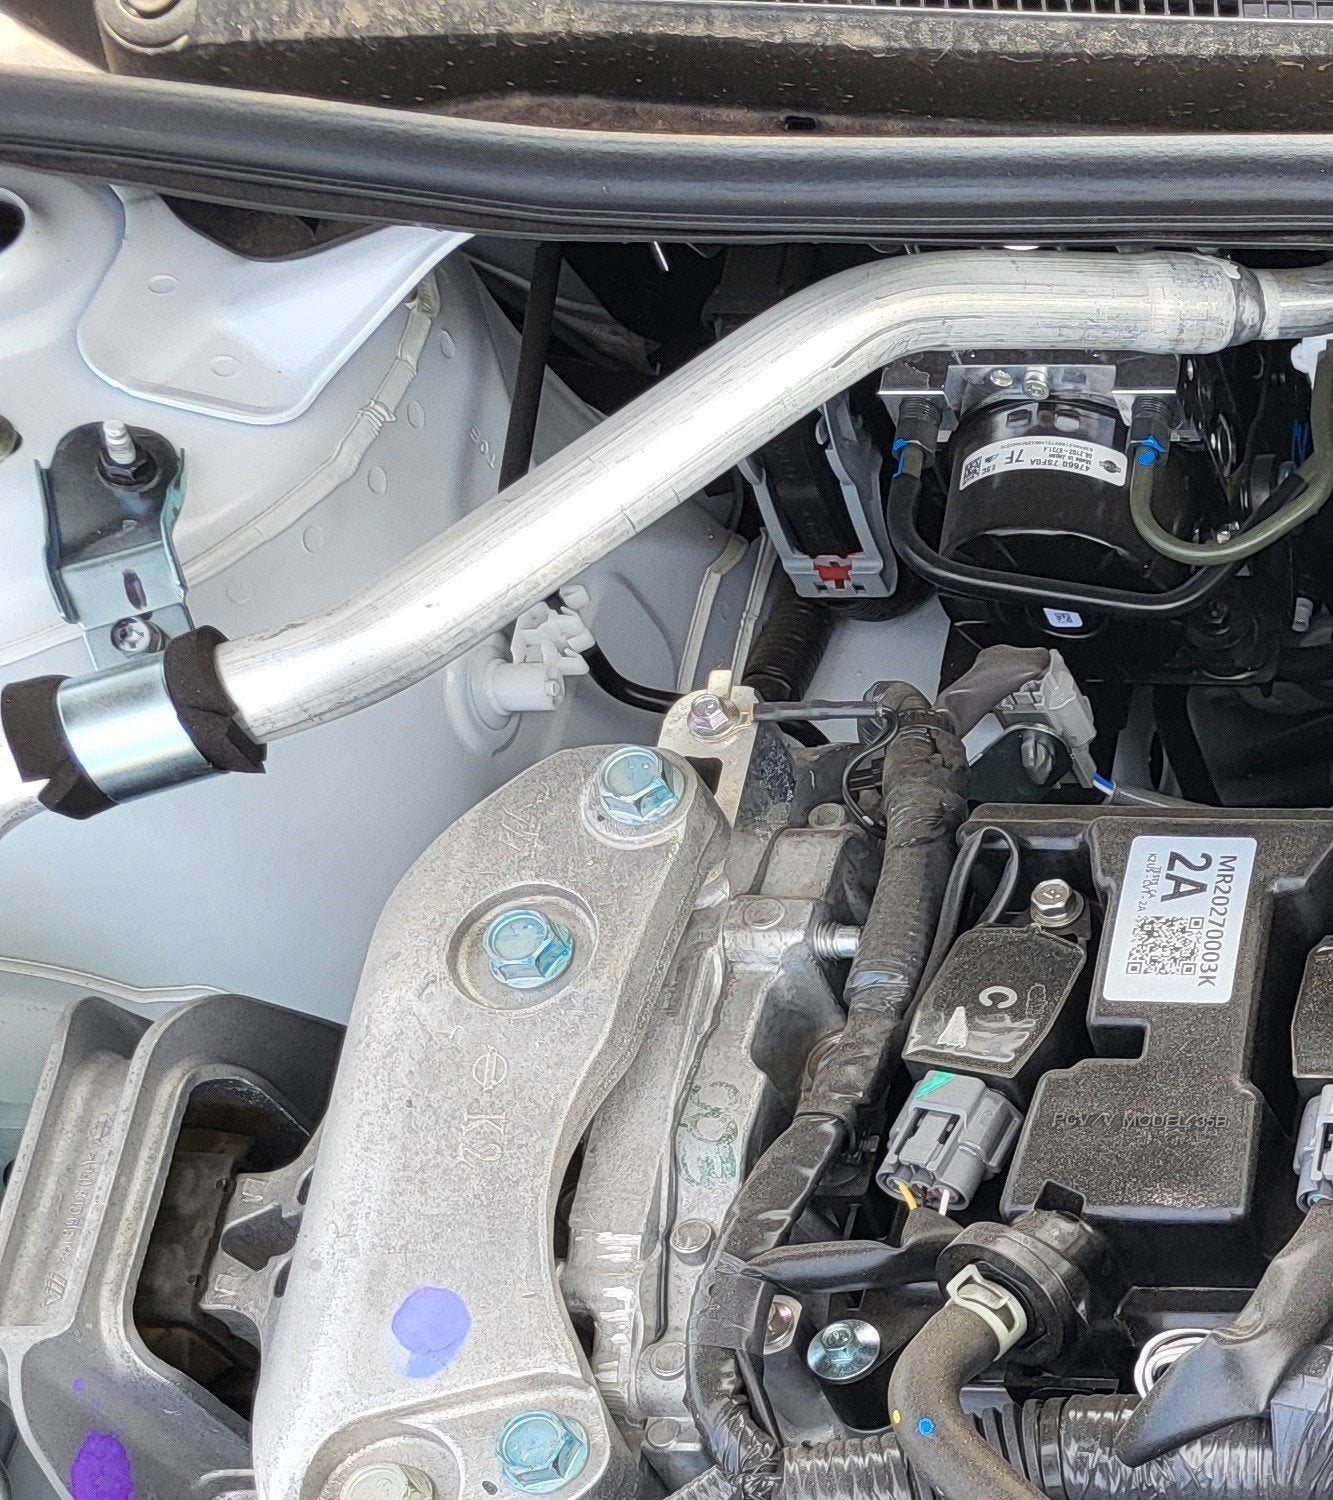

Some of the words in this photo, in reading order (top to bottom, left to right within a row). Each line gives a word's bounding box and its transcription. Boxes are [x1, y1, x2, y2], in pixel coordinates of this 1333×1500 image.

[981, 464, 996, 476] ESC
[1004, 449, 1025, 465] 7F
[1160, 851, 1213, 902] 2A
[1197, 855, 1238, 987] MR20270003K
